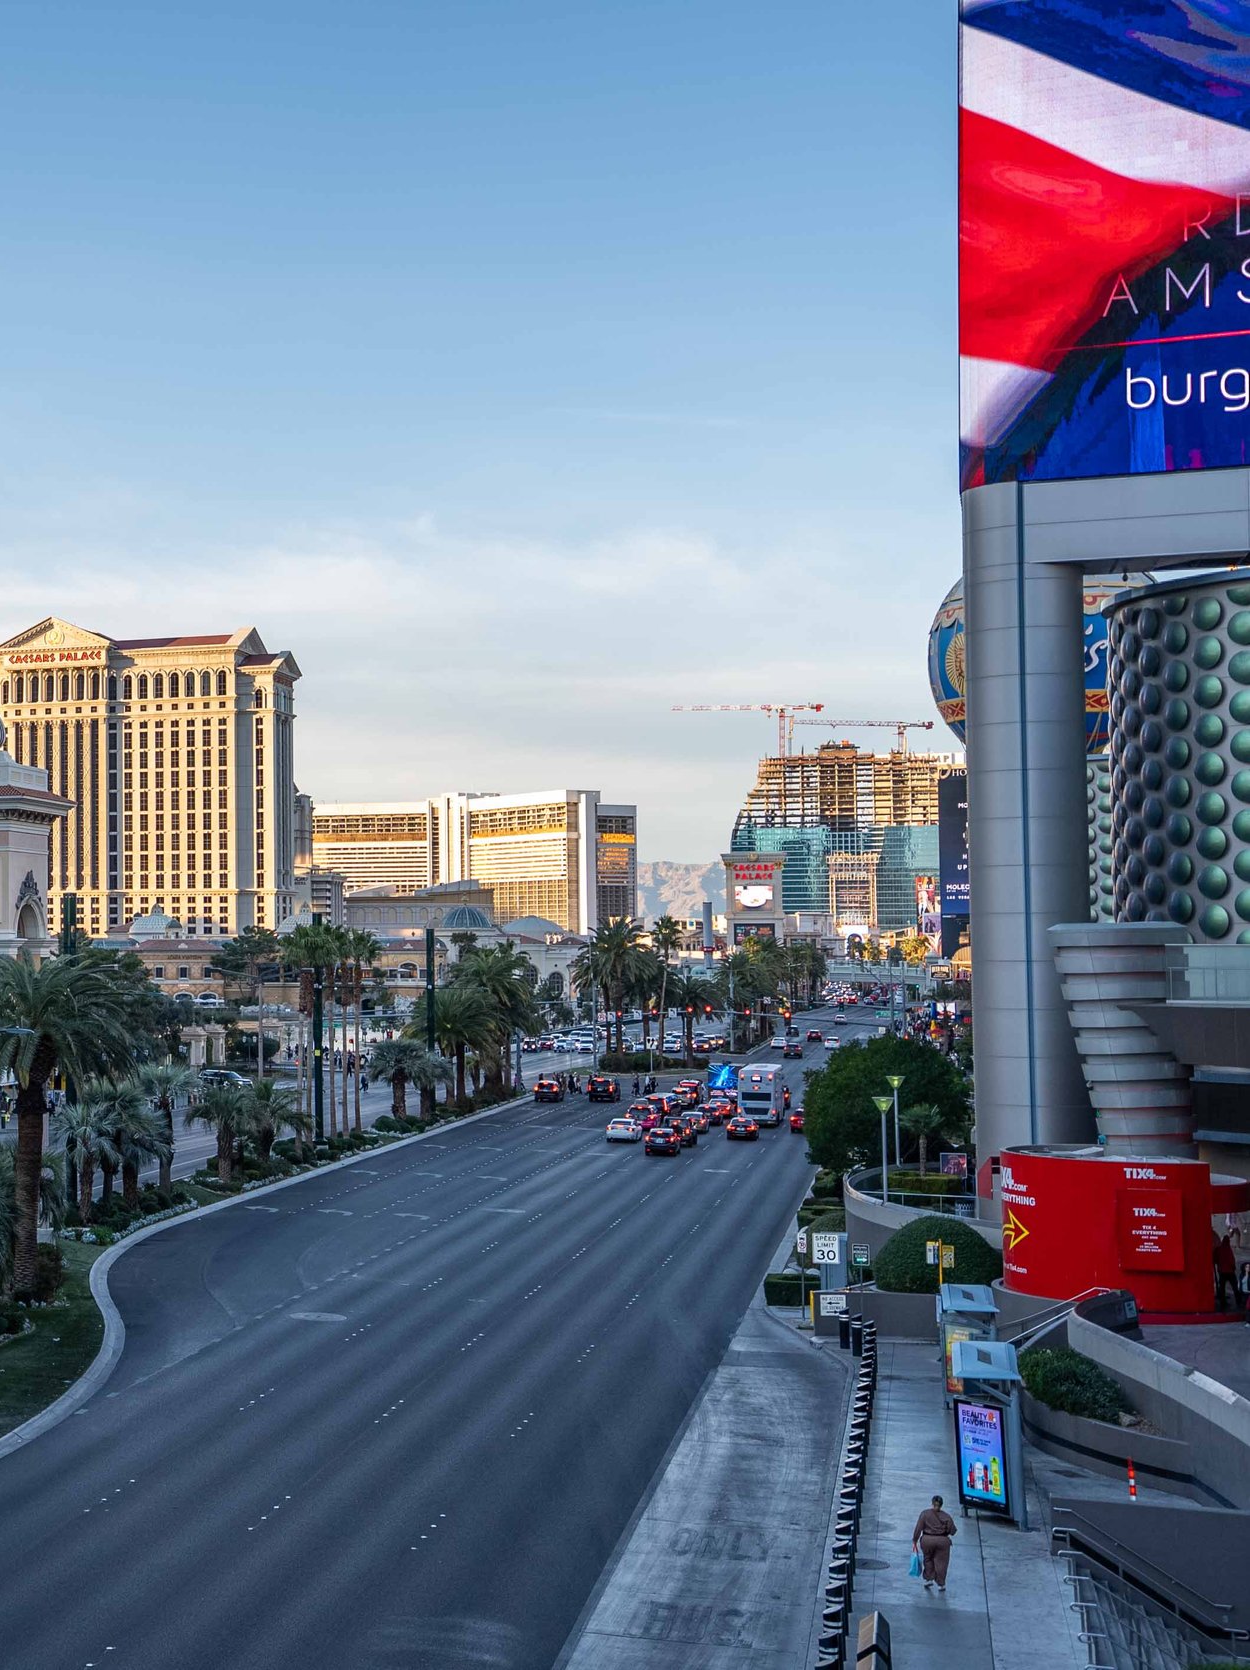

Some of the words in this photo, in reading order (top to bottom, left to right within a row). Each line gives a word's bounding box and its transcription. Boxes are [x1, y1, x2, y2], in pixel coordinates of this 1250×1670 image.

[1125, 366, 1250, 412] burg
[9, 653, 56, 664] CAESARS
[59, 650, 102, 662] PALACE
[735, 872, 773, 880] PALACE
[816, 1249, 837, 1261] 30
[961, 1409, 988, 1420] BEAUTY
[962, 1416, 998, 1430] FAVORITES
